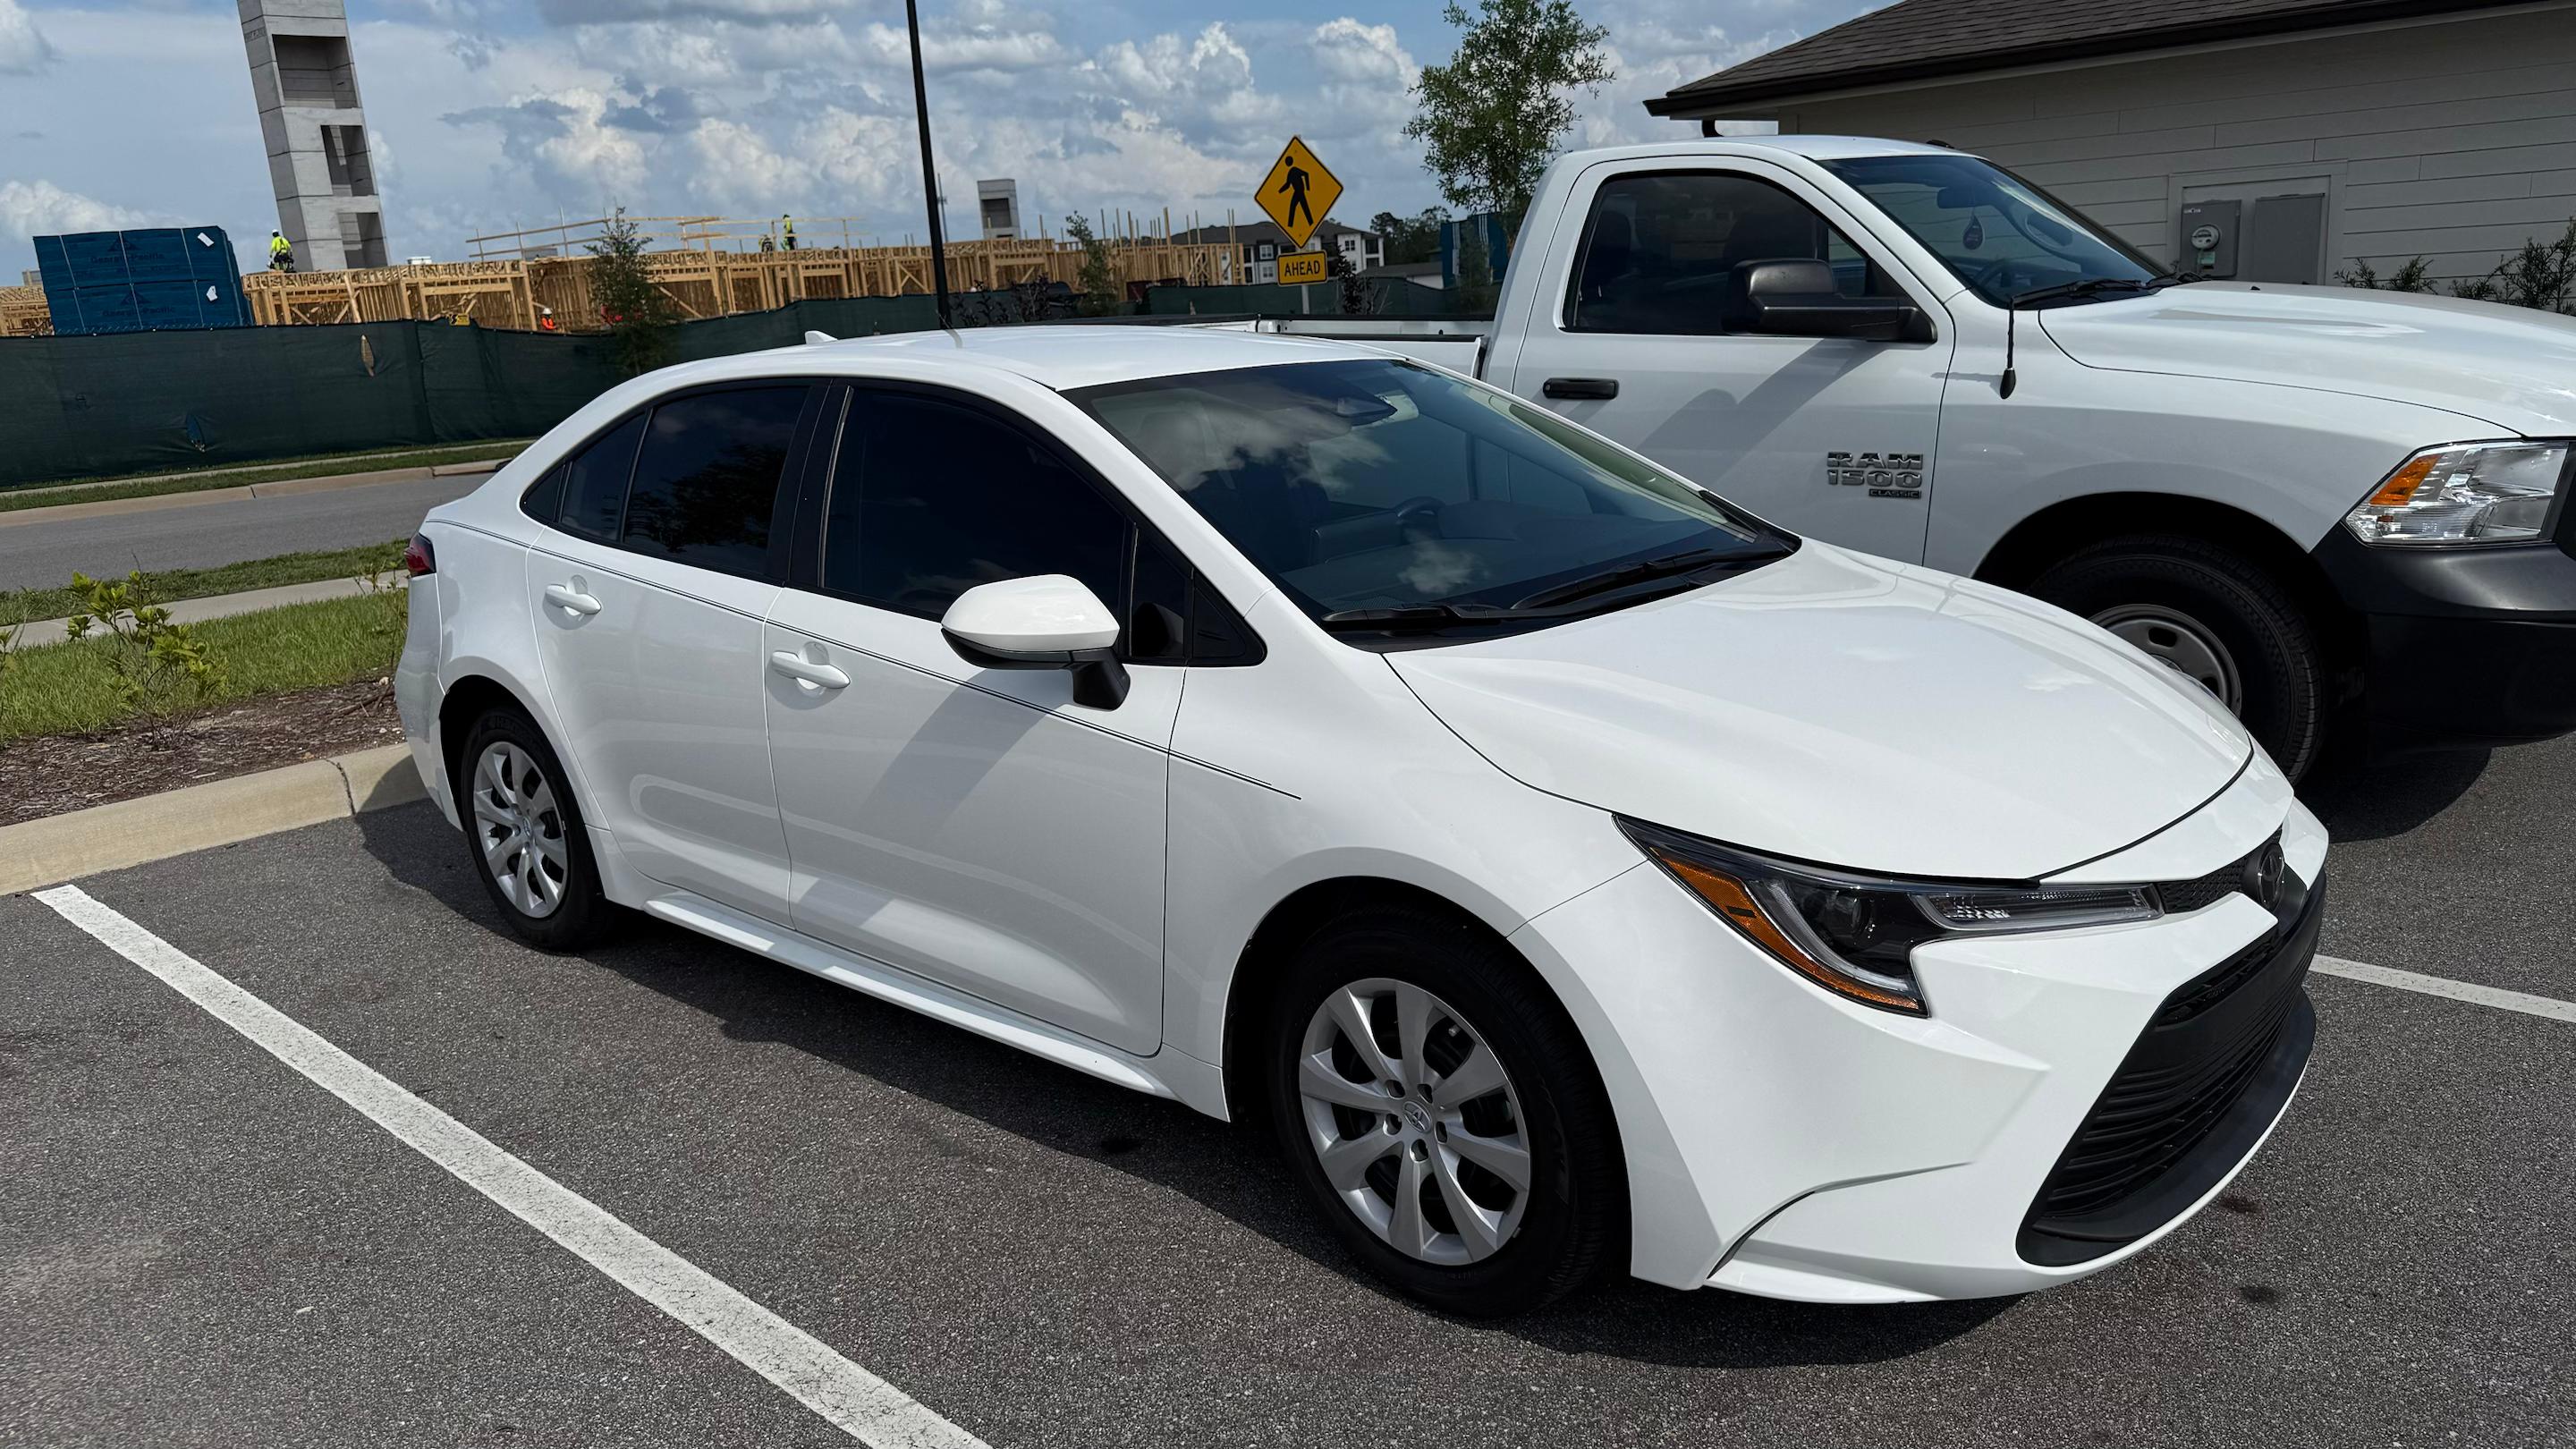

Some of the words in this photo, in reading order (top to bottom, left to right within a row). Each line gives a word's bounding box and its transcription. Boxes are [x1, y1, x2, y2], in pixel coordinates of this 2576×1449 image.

[1284, 260, 1320, 276] AHEAD
[1826, 452, 1923, 470] RAM
[1826, 470, 1922, 488] 1500
[1870, 489, 1920, 498] CLASSIC
